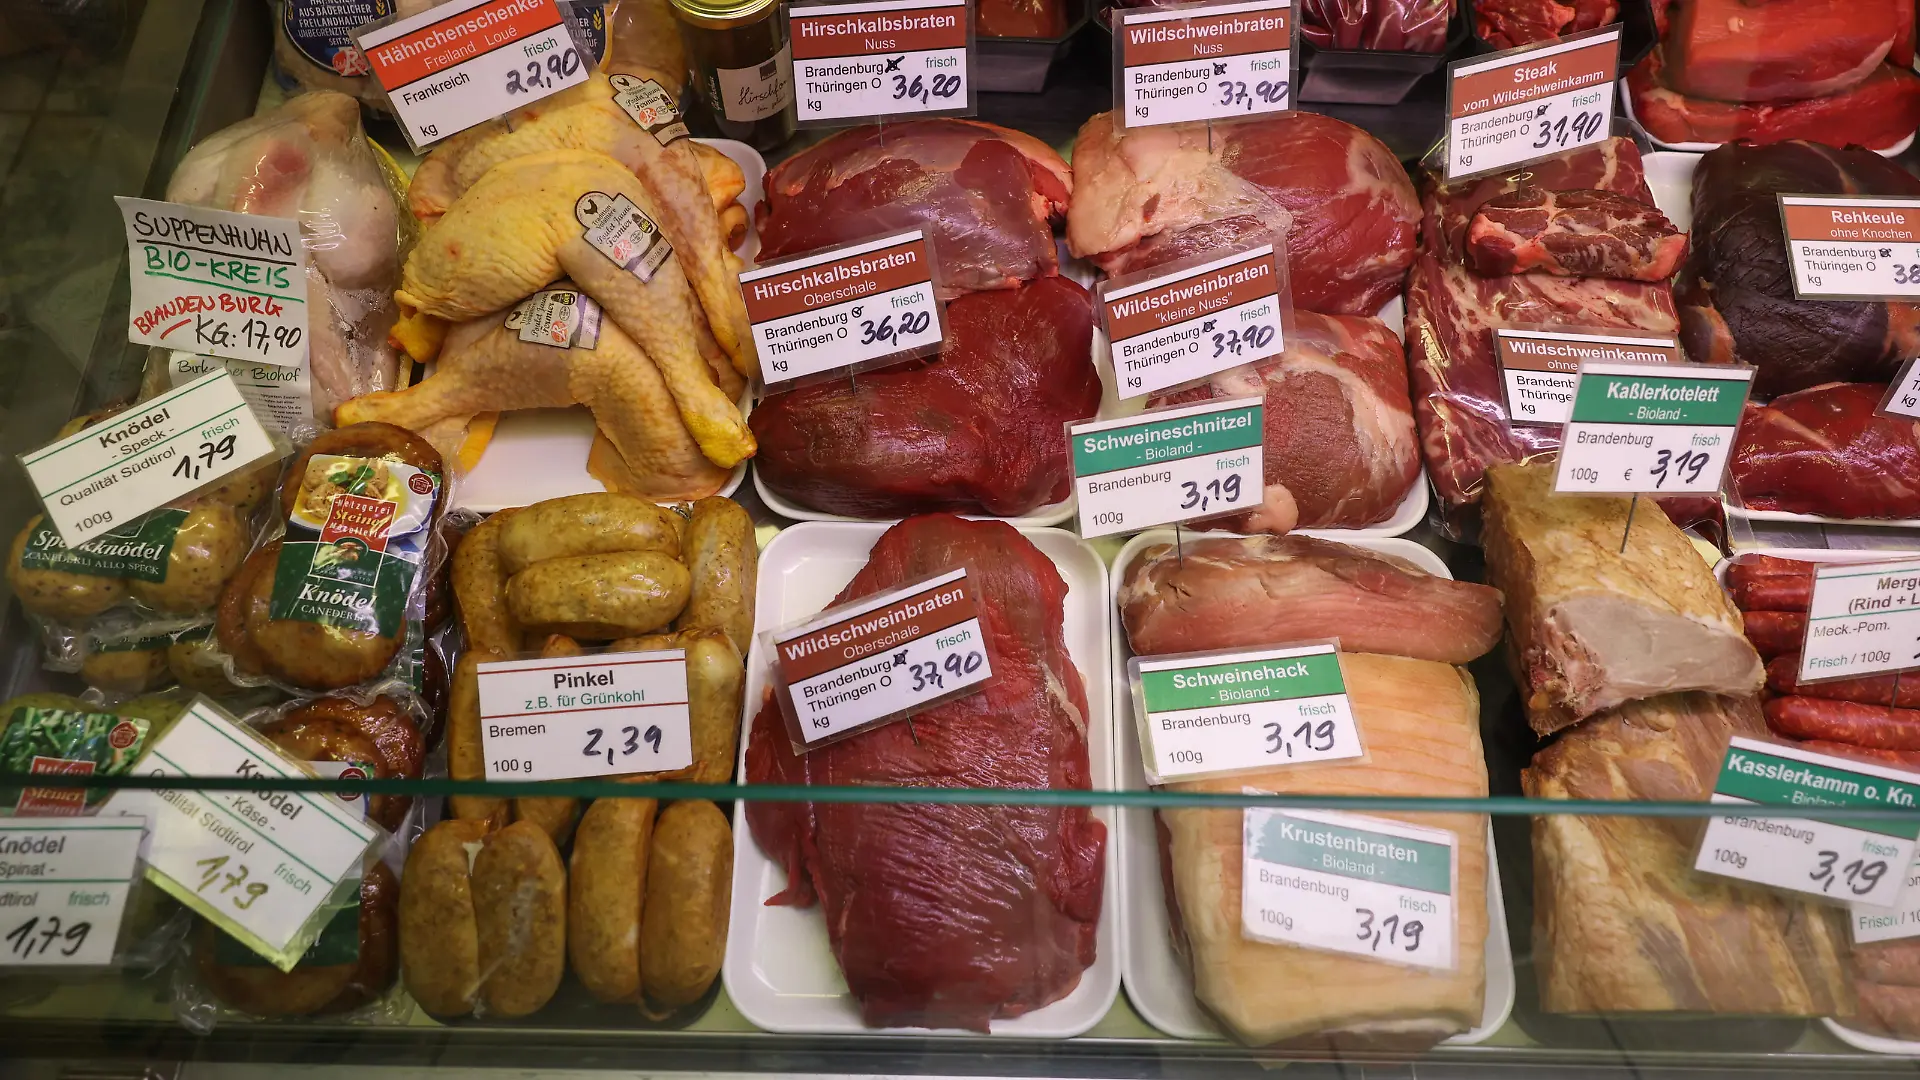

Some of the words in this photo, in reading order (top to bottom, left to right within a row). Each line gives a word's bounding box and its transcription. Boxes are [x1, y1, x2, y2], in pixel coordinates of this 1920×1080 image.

[299, 8, 314, 17] AUS
[299, 15, 375, 28] FREILANDHALTUNG
[377, 0, 545, 67] Hähnchenschenke
[801, 15, 955, 38] Hirschkalbsbraten
[1130, 16, 1284, 45] Wildschweinbraten
[424, 42, 476, 69] Freiland
[484, 25, 518, 46] Loué
[523, 37, 558, 59] frisch
[865, 39, 896, 50] Nuss
[1193, 43, 1223, 55] Nuss
[403, 72, 470, 105] Frankreich
[506, 47, 580, 95] 22,90
[805, 63, 884, 78] Brandenburg
[926, 56, 957, 68] frisch
[1136, 68, 1210, 84] Brandenburg
[1250, 58, 1281, 72] frisch
[1513, 61, 1558, 83] Steak
[806, 80, 867, 94] Thüringen
[892, 74, 961, 104] 36,20
[1135, 85, 1193, 100] Thüringen
[1218, 80, 1289, 110] 37,90
[1463, 98, 1489, 112] vom
[1493, 70, 1604, 105] Wildschweinkamm
[807, 99, 822, 111] kg
[1136, 105, 1148, 118] kg
[1461, 110, 1533, 135] Brandenburg
[1572, 92, 1601, 108] frisch
[420, 123, 438, 137] kg
[1461, 128, 1516, 150] Thüringen
[1533, 111, 1603, 149] 31,90
[1460, 154, 1473, 166] kg
[1831, 210, 1905, 224] Rehkeule
[133, 211, 293, 256] SUPPENHUHN
[1831, 228, 1858, 238] ohne
[1862, 228, 1912, 239] Knochen
[1802, 247, 1876, 260] Brandenburg
[144, 246, 290, 288] BIO-KREIS
[754, 250, 916, 300] Hirschkalbsbraten
[1805, 261, 1863, 273] Thüringen
[1808, 274, 1821, 286] kg
[804, 280, 877, 306] Oberschale
[1112, 264, 1269, 319] Wildschweinbraten
[765, 311, 848, 340] Brandenburg
[891, 291, 924, 309] frisch
[1155, 305, 1195, 324] "kleine
[1199, 292, 1232, 312] Nuss"
[241, 318, 301, 355] 17,90
[768, 333, 833, 355] Thüringen
[861, 310, 930, 346] 36,20
[1123, 327, 1200, 357] Brandenburg
[1240, 305, 1271, 322] frisch
[1125, 350, 1185, 372] Thüringen
[1212, 324, 1275, 358] 37,90
[1509, 341, 1667, 363] Wildschweinkamm
[251, 365, 300, 382] Biohof
[772, 360, 788, 371] kg
[1547, 359, 1578, 370] ohne
[1127, 376, 1142, 387] kg
[1607, 382, 1720, 402] Kaßlerkotelett
[1521, 402, 1536, 414] kg
[1637, 407, 1680, 420] Bioland
[1901, 394, 1917, 407] kg
[99, 408, 171, 449] Knödel
[1084, 412, 1252, 453] Schweineschnitzel
[1577, 431, 1653, 447] Brandenburg
[1691, 433, 1720, 447] frisch
[120, 431, 167, 455] Speck
[1145, 442, 1193, 460] Bioland
[60, 474, 119, 507] Qualität
[120, 446, 176, 478] Südtirol
[201, 417, 240, 441] frisch
[172, 434, 237, 480] 1,79
[1570, 468, 1598, 483] 100g
[1624, 468, 1632, 480] €
[1650, 449, 1710, 489] 3,19
[1089, 471, 1171, 494] Brandenburg
[1216, 455, 1249, 470] frisch
[1181, 473, 1241, 511] 3,19
[75, 509, 113, 533] 100g
[1093, 511, 1123, 526] 100g
[33, 530, 165, 561] Speknödel
[95, 561, 125, 569] ALLO
[128, 563, 159, 575] SPECK
[298, 583, 378, 610] Knödel
[1877, 577, 1920, 590] Merg
[1849, 595, 1892, 614] (Rind
[785, 588, 964, 661] Wildschweinbraten
[1814, 621, 1890, 638] Meck.-Pom.
[843, 624, 920, 659] Oberschale
[803, 660, 892, 698] Brandenburg
[936, 629, 971, 651] frisch
[1809, 654, 1848, 669] Frisch
[1861, 651, 1891, 663] 100g
[554, 670, 614, 689] Pinkel
[808, 683, 876, 713] Thüringen
[909, 651, 982, 692] 37,90
[1173, 662, 1309, 689] Schweinehack
[525, 696, 552, 710] z.B.
[557, 694, 576, 707] für
[580, 690, 645, 705] Grünkohl
[1220, 686, 1270, 701] Bioland
[812, 716, 830, 728] kg
[1162, 713, 1251, 731] Brandenburg
[1299, 703, 1336, 716] frisch
[489, 724, 546, 738] Bremen
[582, 725, 663, 765] 2,39
[1263, 720, 1336, 758] 3,19
[492, 759, 519, 772] 100
[524, 760, 533, 773] g
[1168, 750, 1203, 764] 100g
[1727, 753, 1859, 795] Kasslerkamm
[1864, 785, 1880, 800] o.
[1886, 787, 1916, 808] Kn.
[231, 797, 269, 829] Käse
[199, 812, 255, 854] Südtirol
[1281, 822, 1418, 863] Krustenbraten
[1862, 839, 1899, 858] frisch
[1322, 854, 1374, 875] Bioland
[1714, 848, 1748, 869] 100g
[1809, 850, 1888, 895] 3,19
[196, 854, 269, 911] 1,79
[273, 863, 312, 895] frisch
[1260, 869, 1349, 901] Brandenburg
[1399, 895, 1437, 914] frisch
[68, 891, 110, 906] frisch
[1260, 909, 1293, 931] 100g
[1356, 907, 1424, 951] 3,19
[6, 916, 92, 960] 1,79
